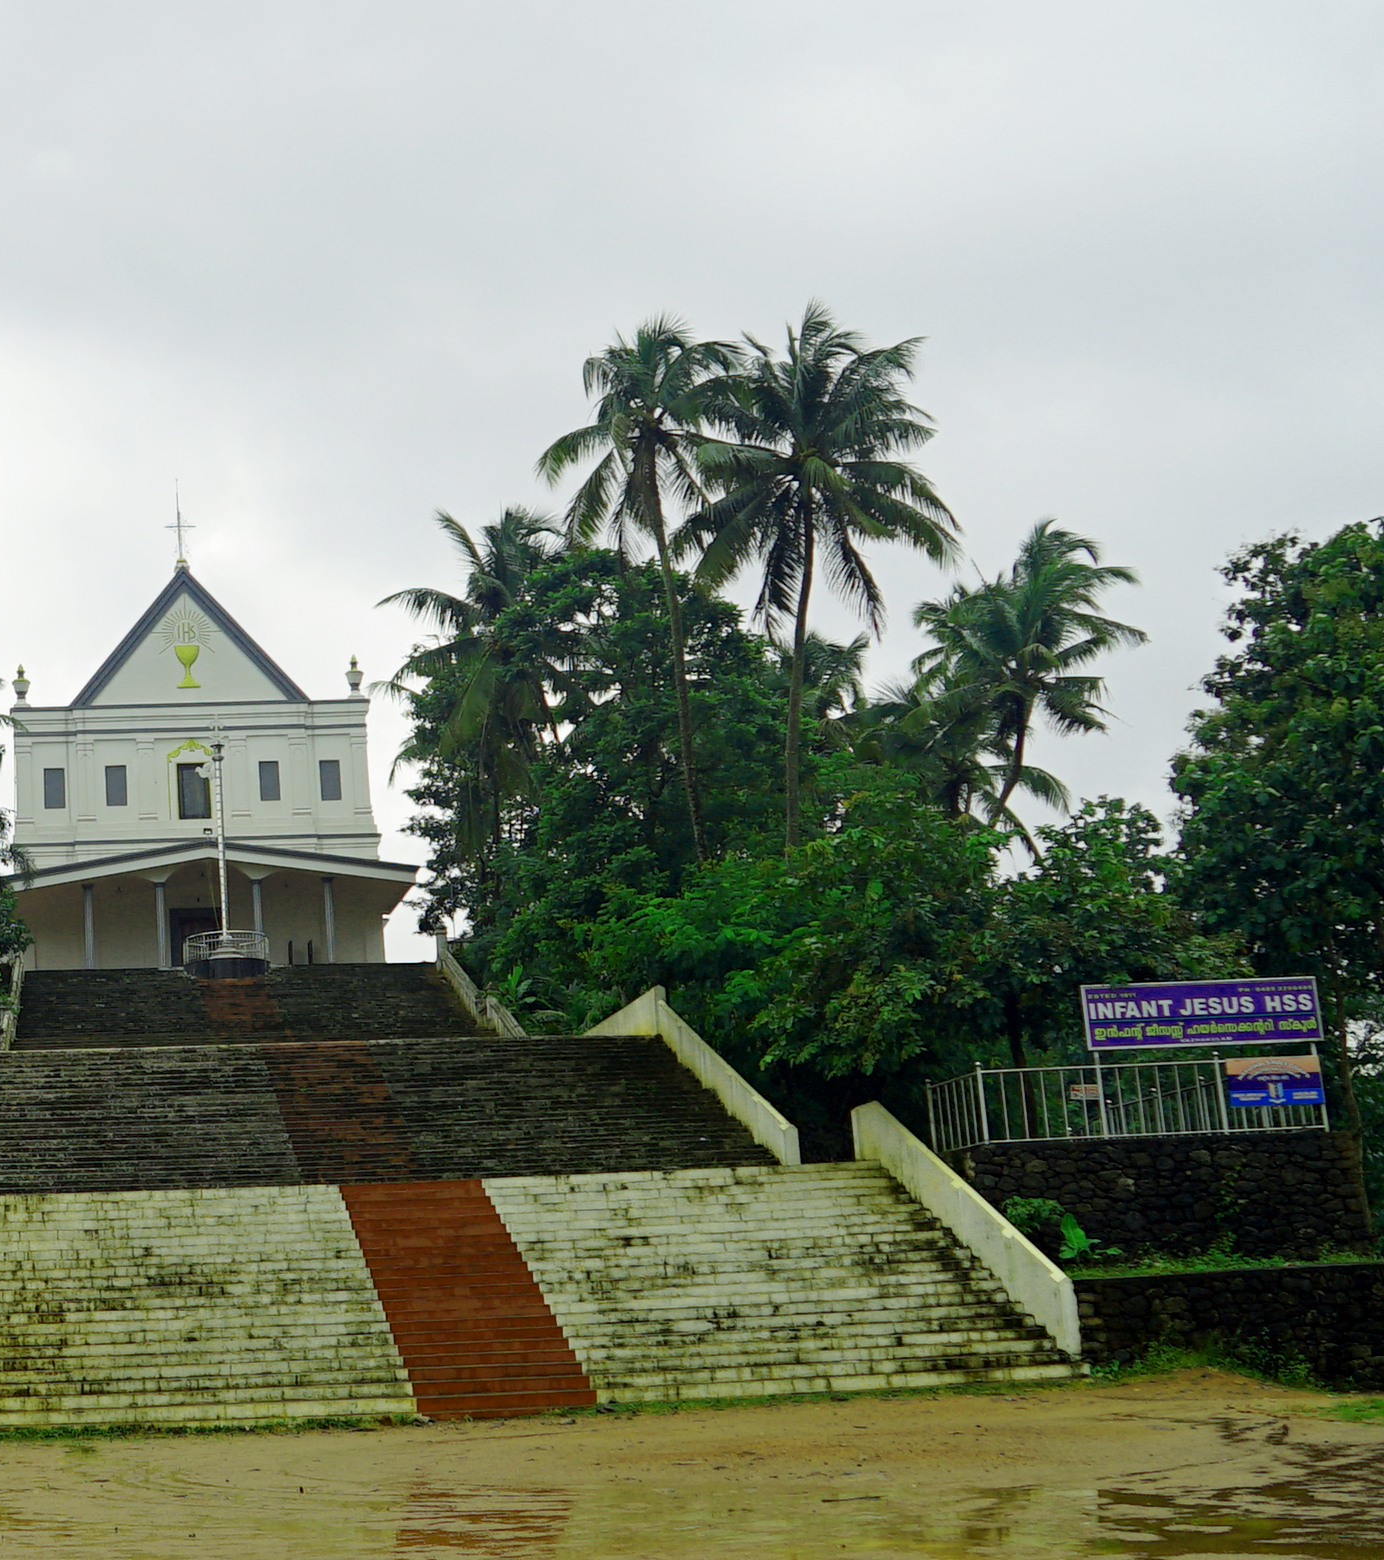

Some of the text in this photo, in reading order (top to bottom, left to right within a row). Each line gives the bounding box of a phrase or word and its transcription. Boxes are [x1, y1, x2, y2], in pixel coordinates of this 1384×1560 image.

[178, 622, 196, 641] IHS
[1088, 993, 1313, 1020] INFANT JESUS HSS
